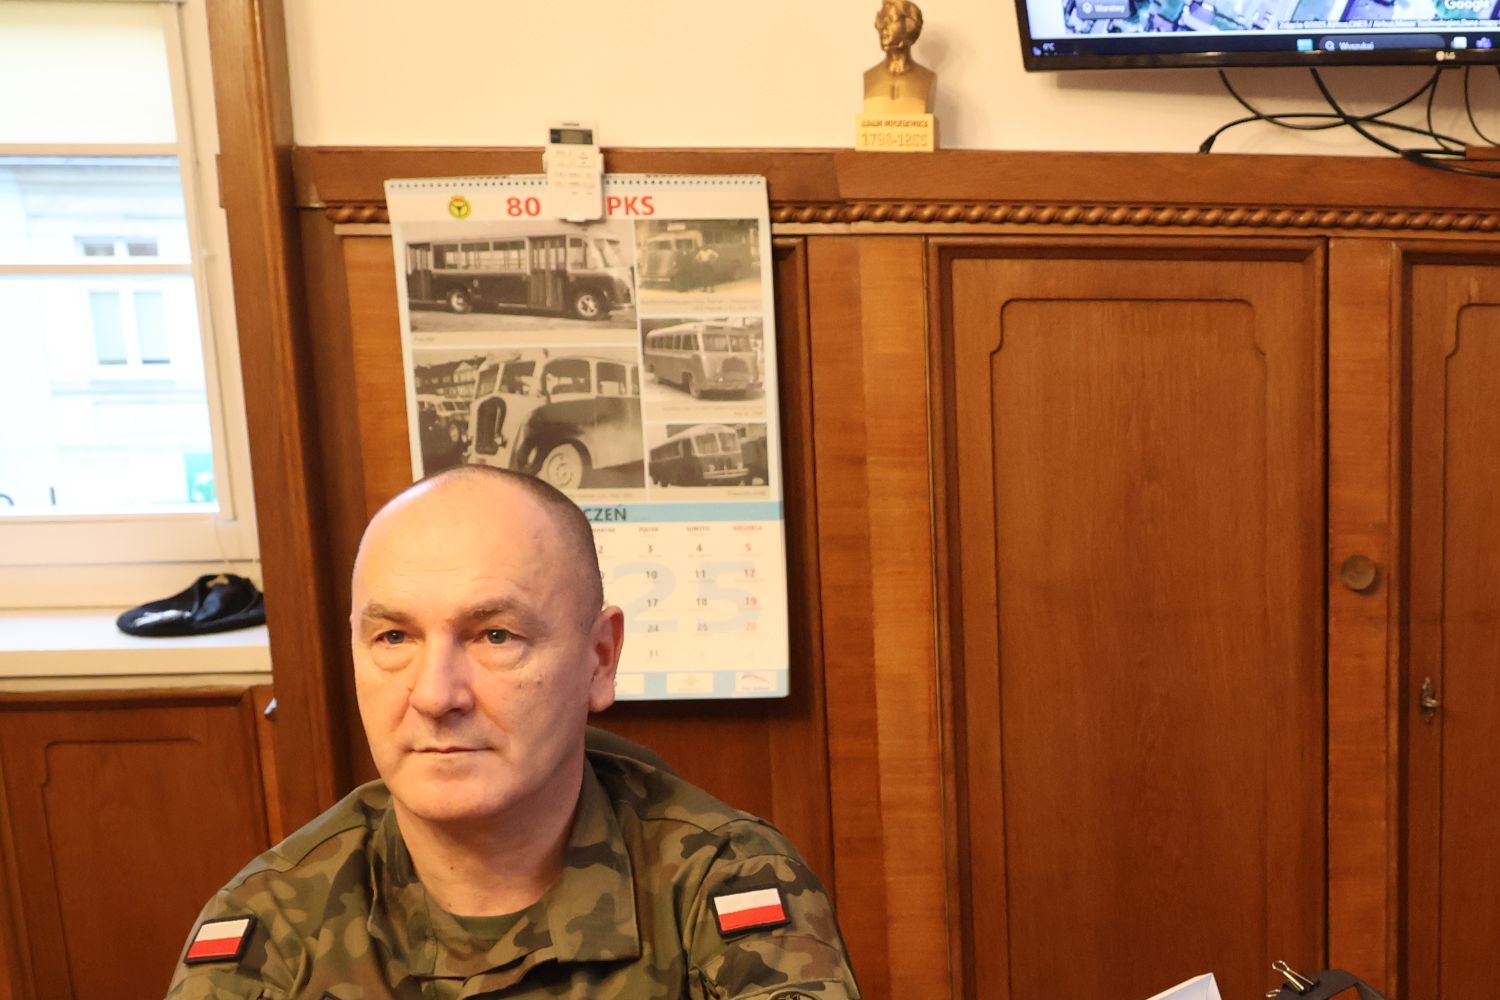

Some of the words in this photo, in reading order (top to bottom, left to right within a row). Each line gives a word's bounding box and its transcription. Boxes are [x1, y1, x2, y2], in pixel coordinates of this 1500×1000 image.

[1444, 51, 1456, 60] LG
[507, 197, 541, 217] 80
[607, 196, 656, 216] PKS
[648, 544, 653, 554] 3
[696, 543, 703, 553] 4
[745, 542, 751, 552] 5
[646, 570, 658, 579] 10
[695, 569, 707, 579] 11
[744, 568, 756, 578] 12
[647, 598, 659, 608] 17
[696, 597, 708, 607] 18
[745, 596, 757, 606] 19
